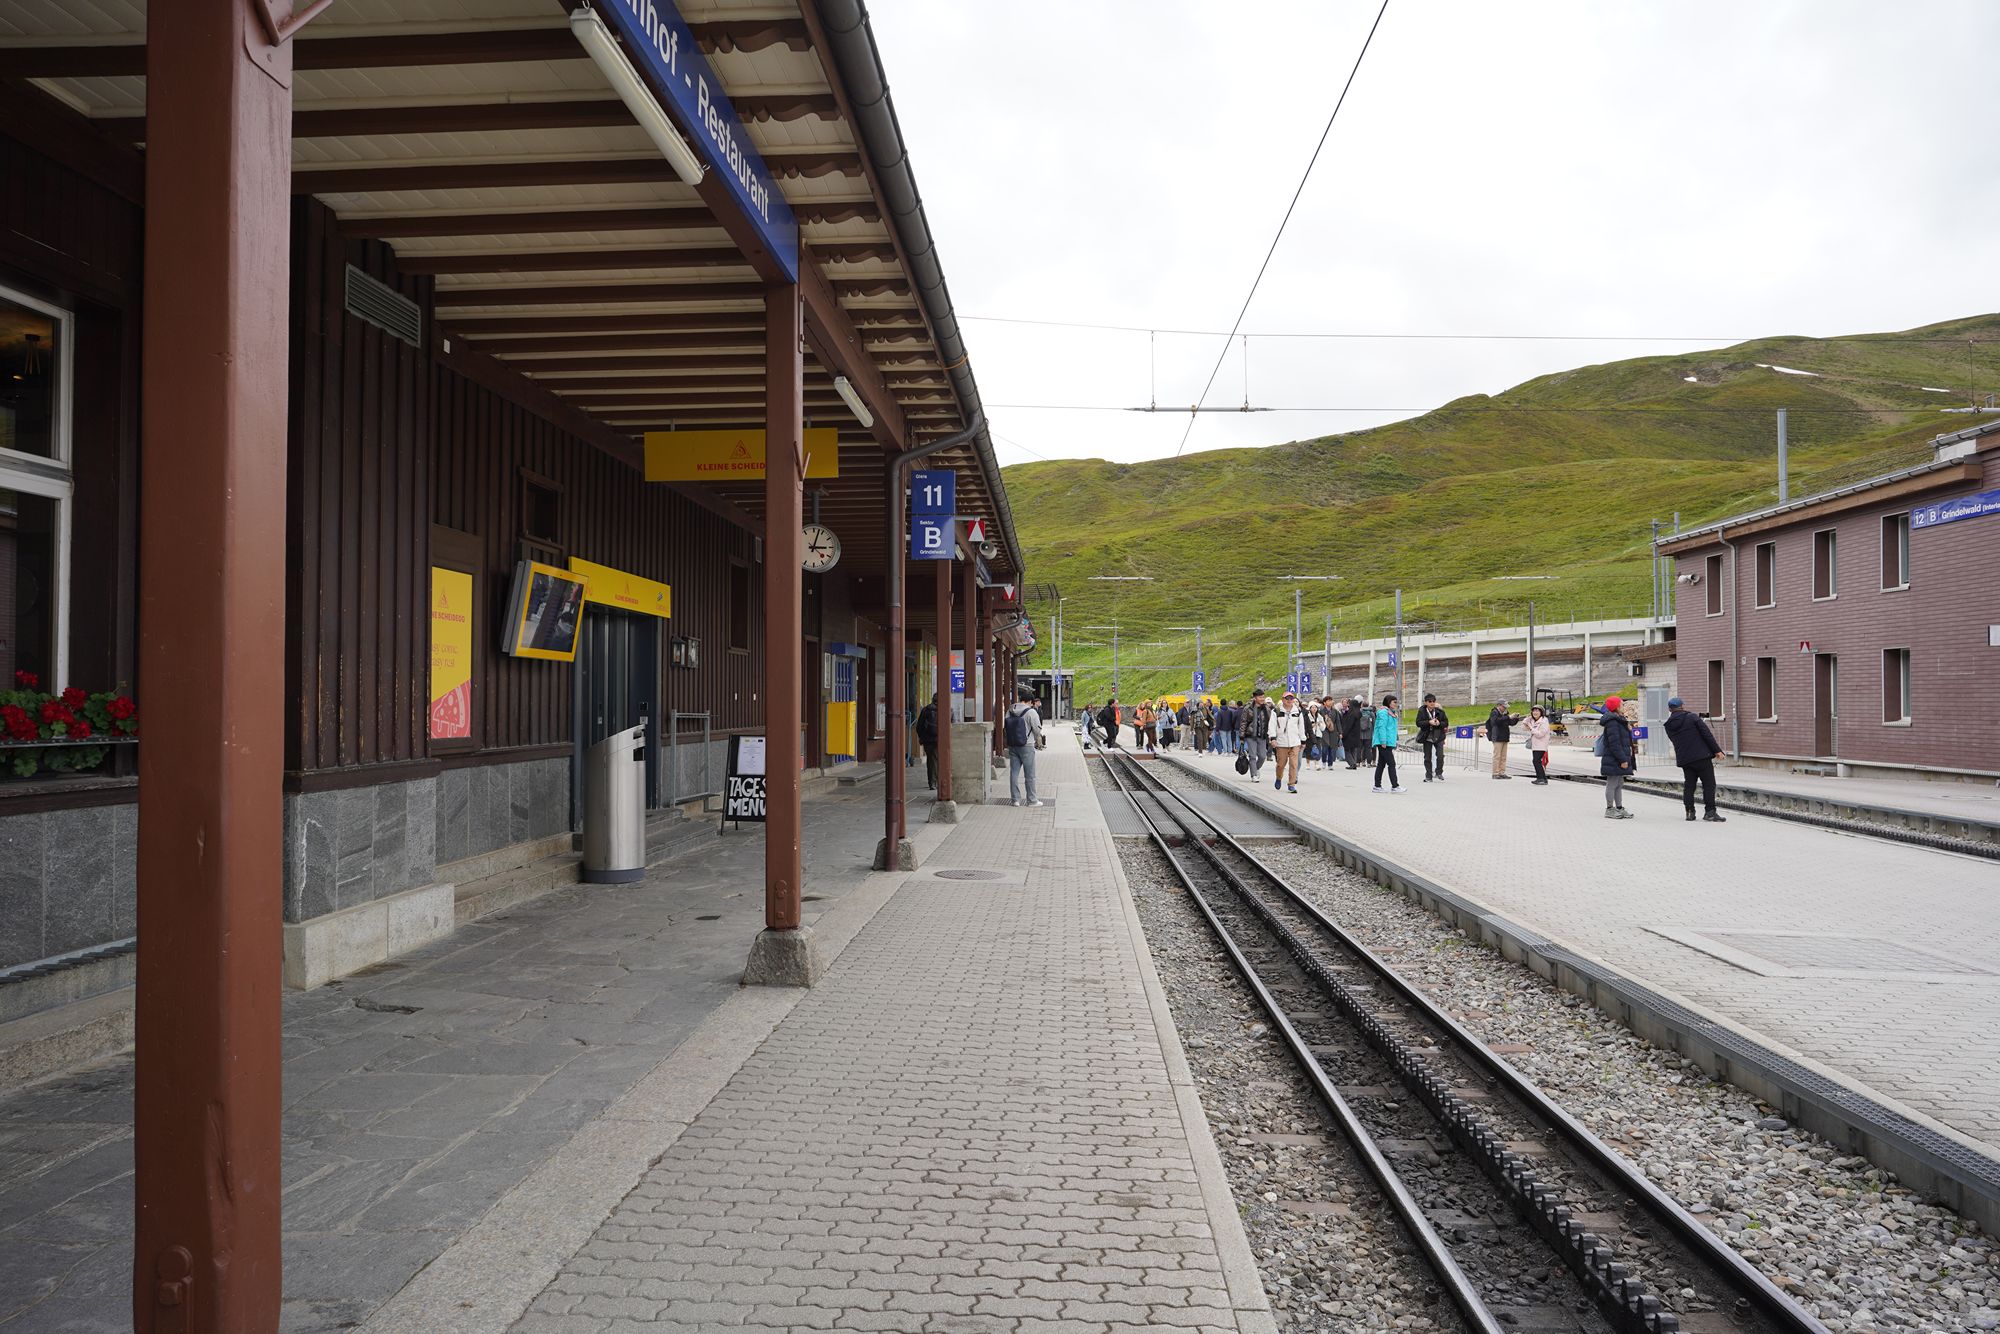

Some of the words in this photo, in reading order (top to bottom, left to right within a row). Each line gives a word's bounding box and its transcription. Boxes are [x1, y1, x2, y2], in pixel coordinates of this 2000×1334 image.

[697, 73, 769, 224] Restaurant
[696, 463, 729, 471] KLEINE
[923, 485, 942, 507] 11
[1915, 513, 1925, 525] 12
[1929, 511, 1937, 522] B
[1941, 503, 1982, 520] Grindelwald
[924, 527, 942, 548] B
